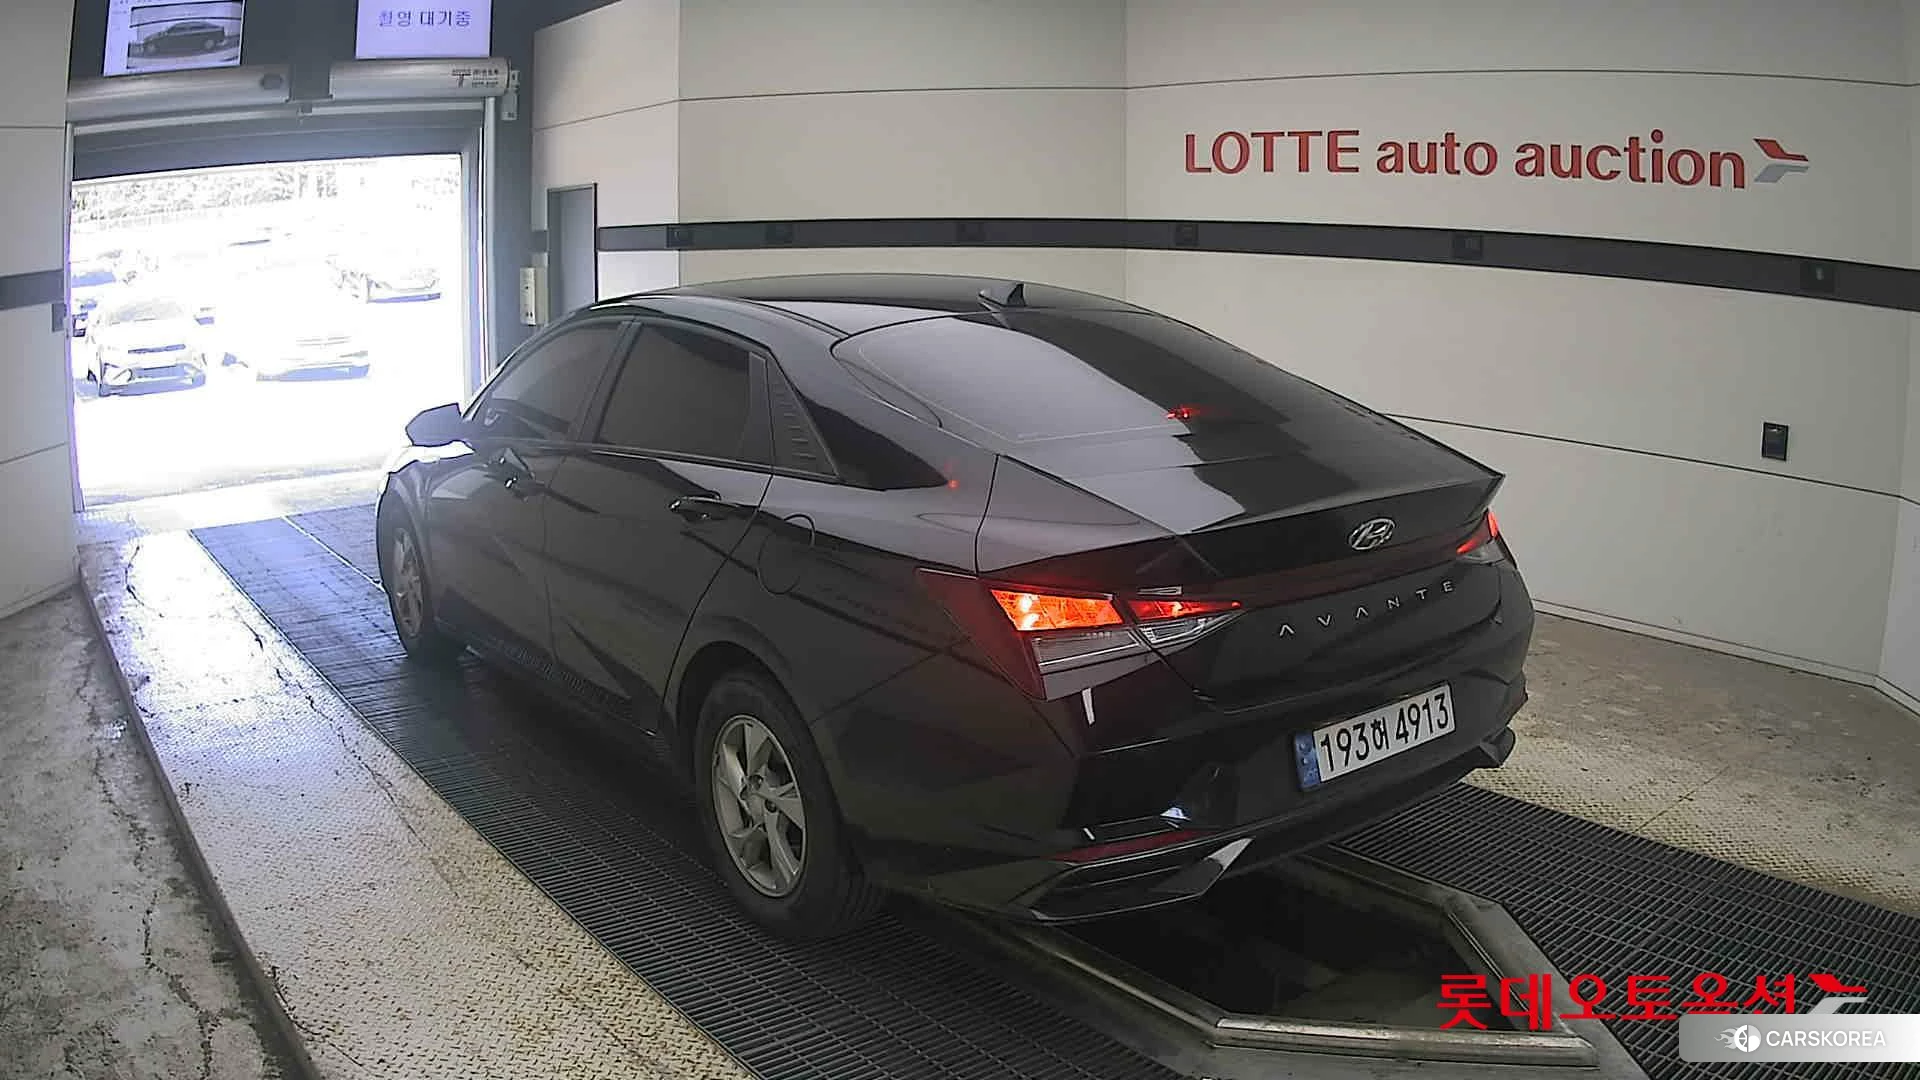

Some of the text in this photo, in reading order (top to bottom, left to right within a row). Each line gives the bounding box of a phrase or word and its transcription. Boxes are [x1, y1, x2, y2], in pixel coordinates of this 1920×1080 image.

[420, 10, 472, 27] 대기중
[1185, 129, 1745, 189] LOTTE auto auction
[1279, 580, 1453, 637] AVANTE
[1320, 693, 1449, 772] 193허 4913
